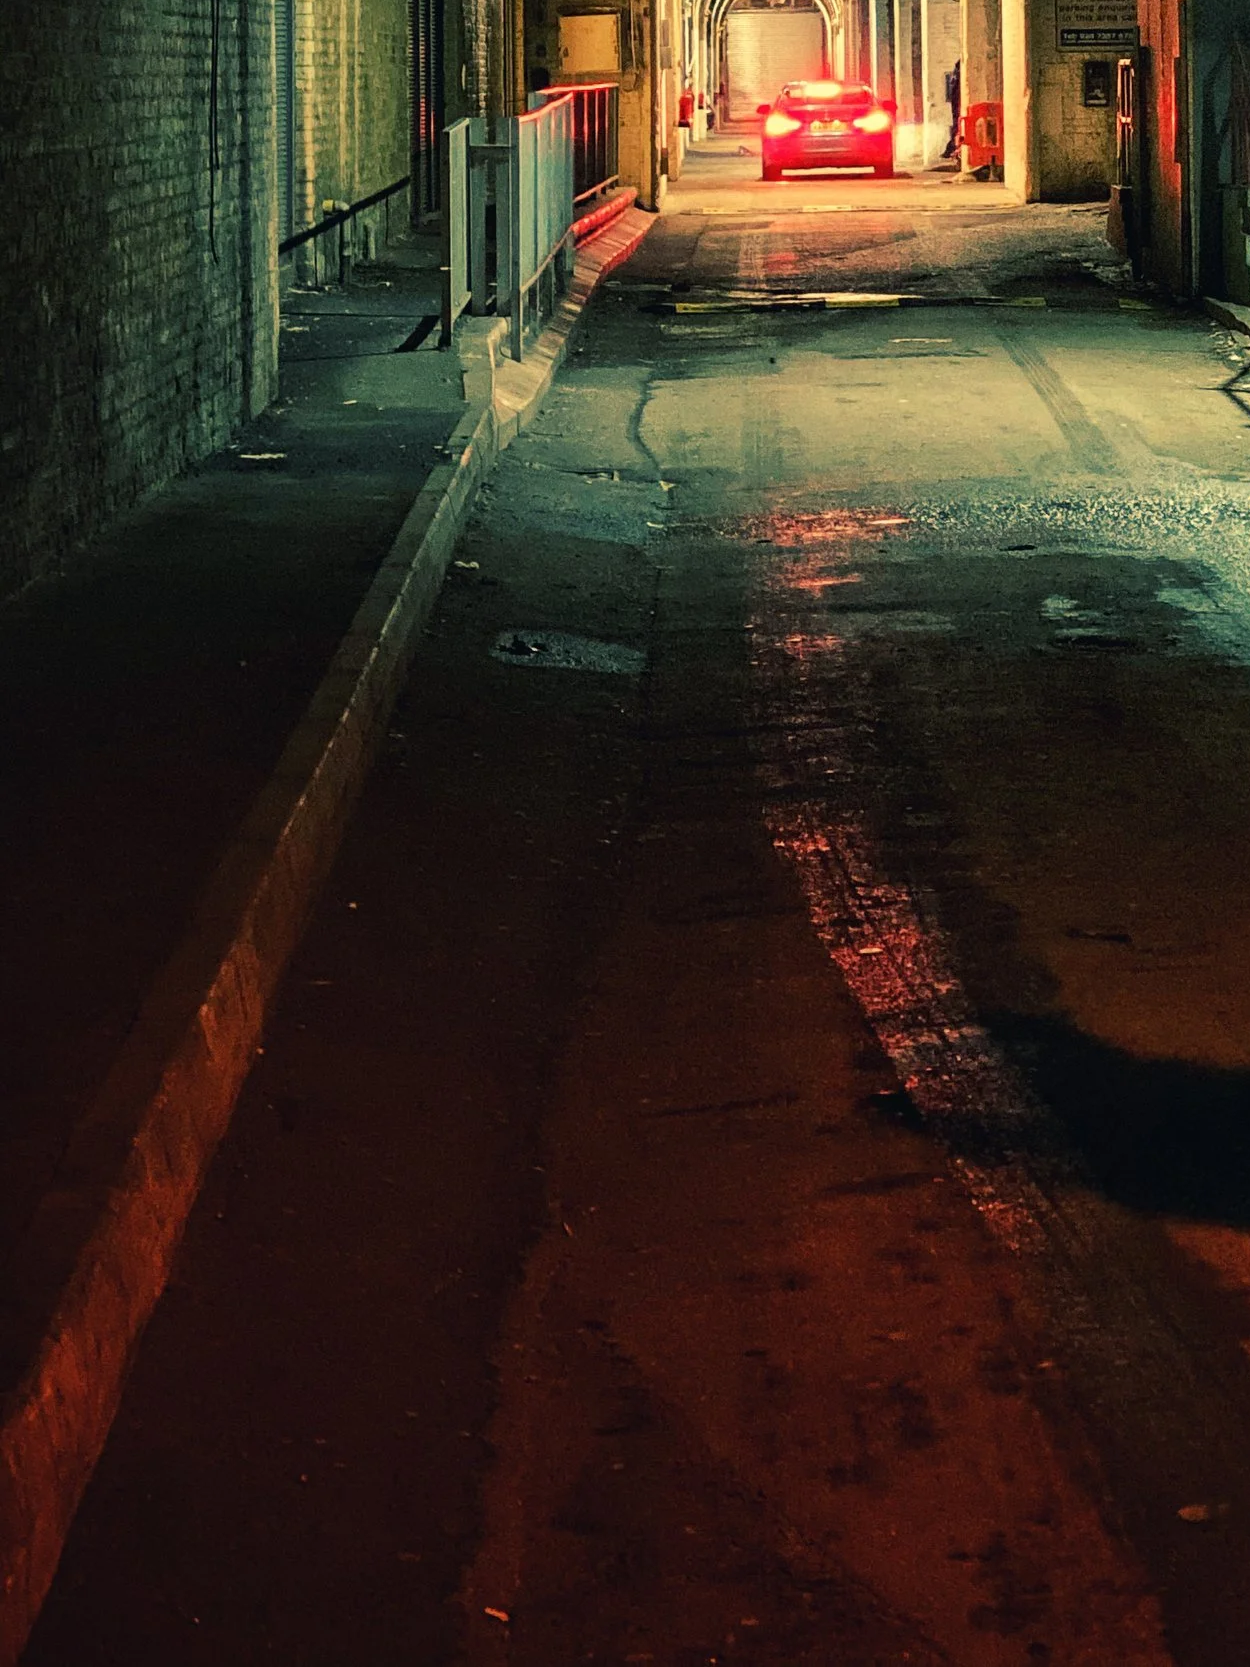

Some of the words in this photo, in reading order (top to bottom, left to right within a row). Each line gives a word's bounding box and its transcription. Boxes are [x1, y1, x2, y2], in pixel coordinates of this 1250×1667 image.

[1059, 5, 1094, 13] parking
[1098, 4, 1136, 12] enquirie
[1075, 14, 1093, 22] this
[1097, 14, 1118, 22] area
